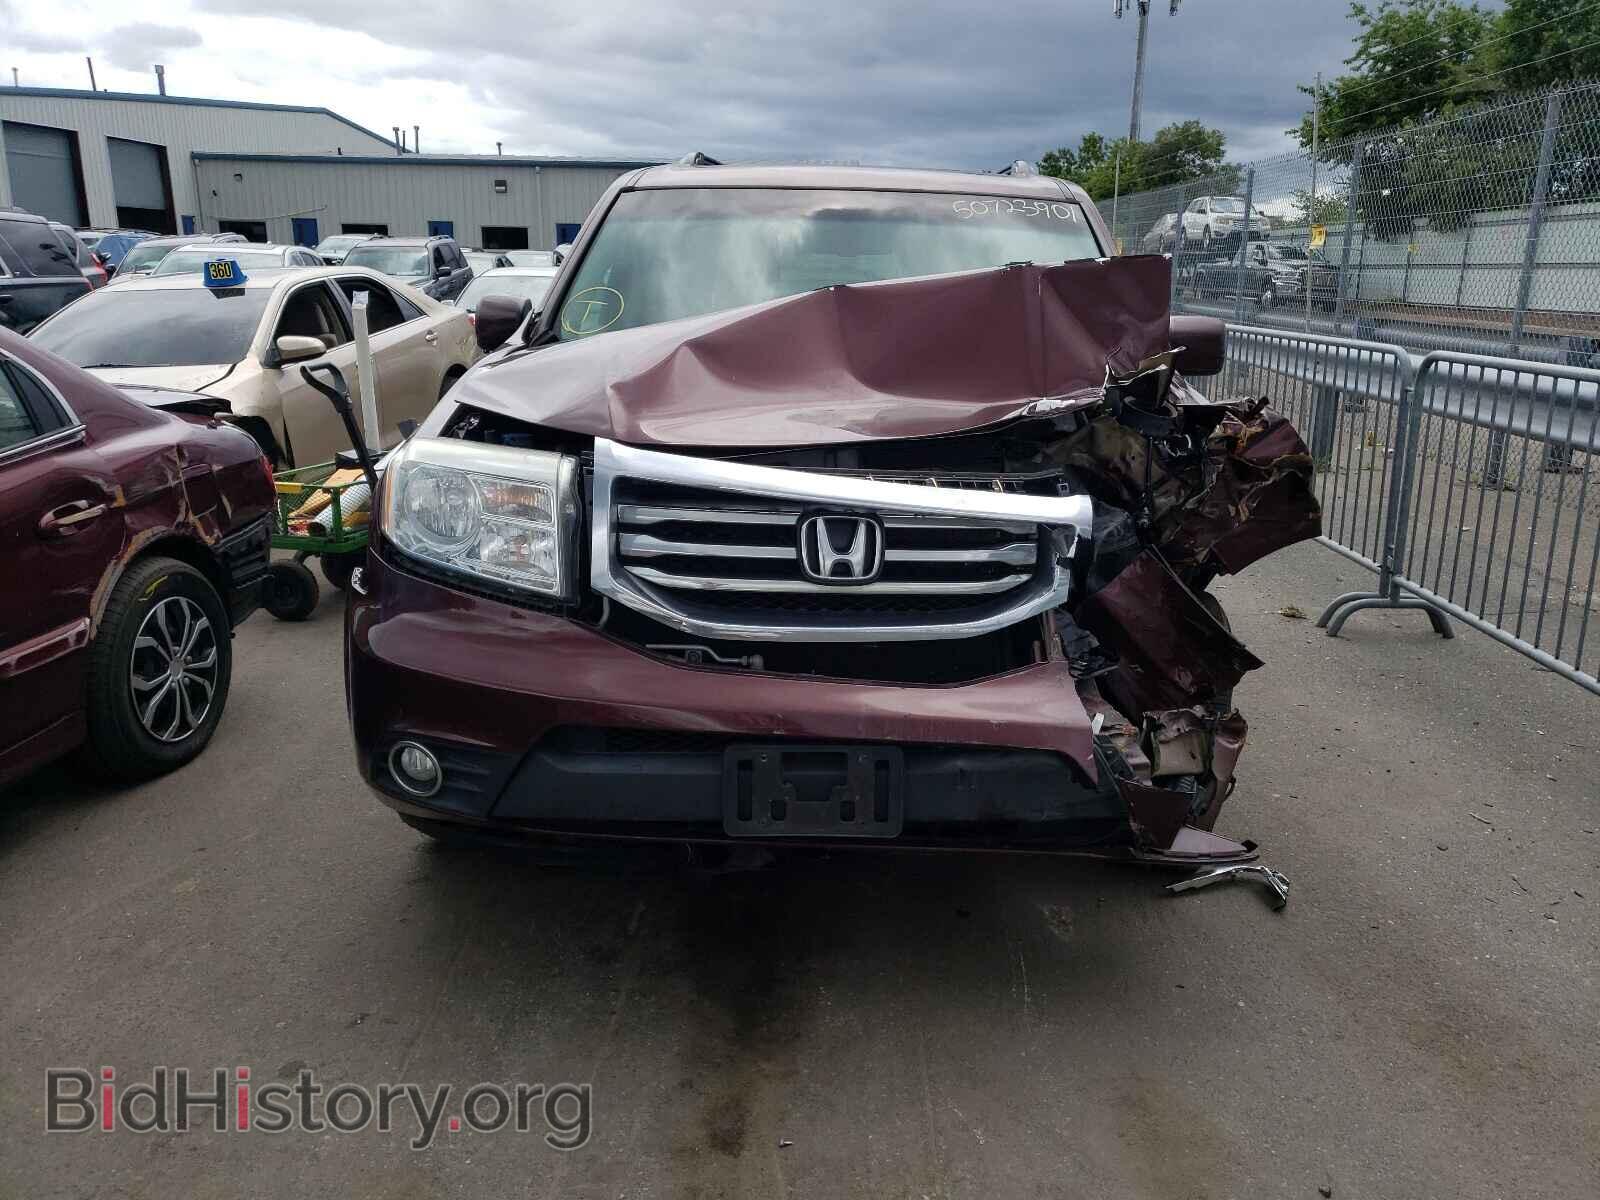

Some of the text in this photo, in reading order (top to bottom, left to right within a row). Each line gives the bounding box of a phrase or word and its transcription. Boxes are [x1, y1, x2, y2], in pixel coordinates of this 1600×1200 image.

[952, 200, 1077, 223] 50723901
[209, 262, 232, 279] 360
[575, 299, 609, 323] T
